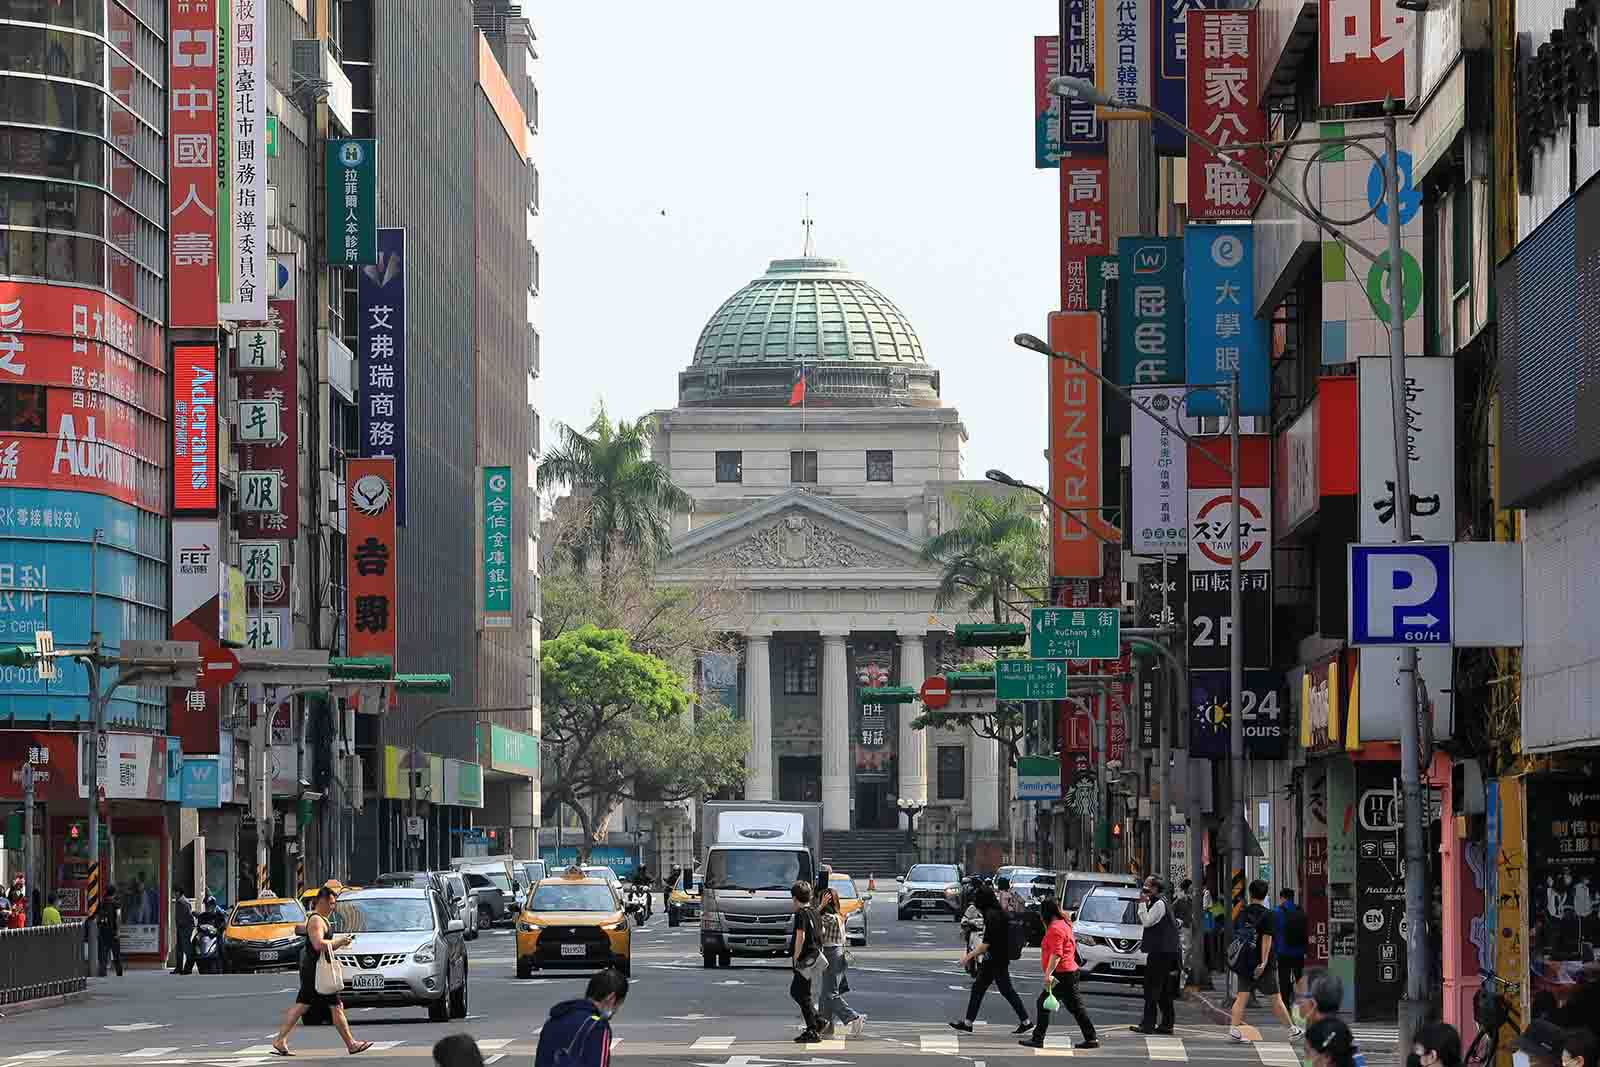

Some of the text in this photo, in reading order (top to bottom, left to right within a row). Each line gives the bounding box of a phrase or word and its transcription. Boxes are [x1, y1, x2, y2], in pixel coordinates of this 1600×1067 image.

[171, 85, 215, 267] 中國人壽
[344, 169, 359, 263] 拉菲爾人本診所
[1067, 168, 1103, 245] 高點
[1067, 261, 1084, 309] 研究所
[368, 304, 395, 459] 艾弗瑞商務
[191, 363, 215, 490] Aderans
[1061, 350, 1088, 541] ORANGE
[180, 552, 211, 565] FET
[353, 537, 390, 633] 吉野
[487, 497, 509, 602] 合作金庫銀行
[1043, 611, 1113, 626] 許昌街
[1367, 553, 1438, 638] P
[1404, 631, 1441, 641] 60/H
[1240, 690, 1281, 720] 24
[1242, 725, 1281, 737] ours
